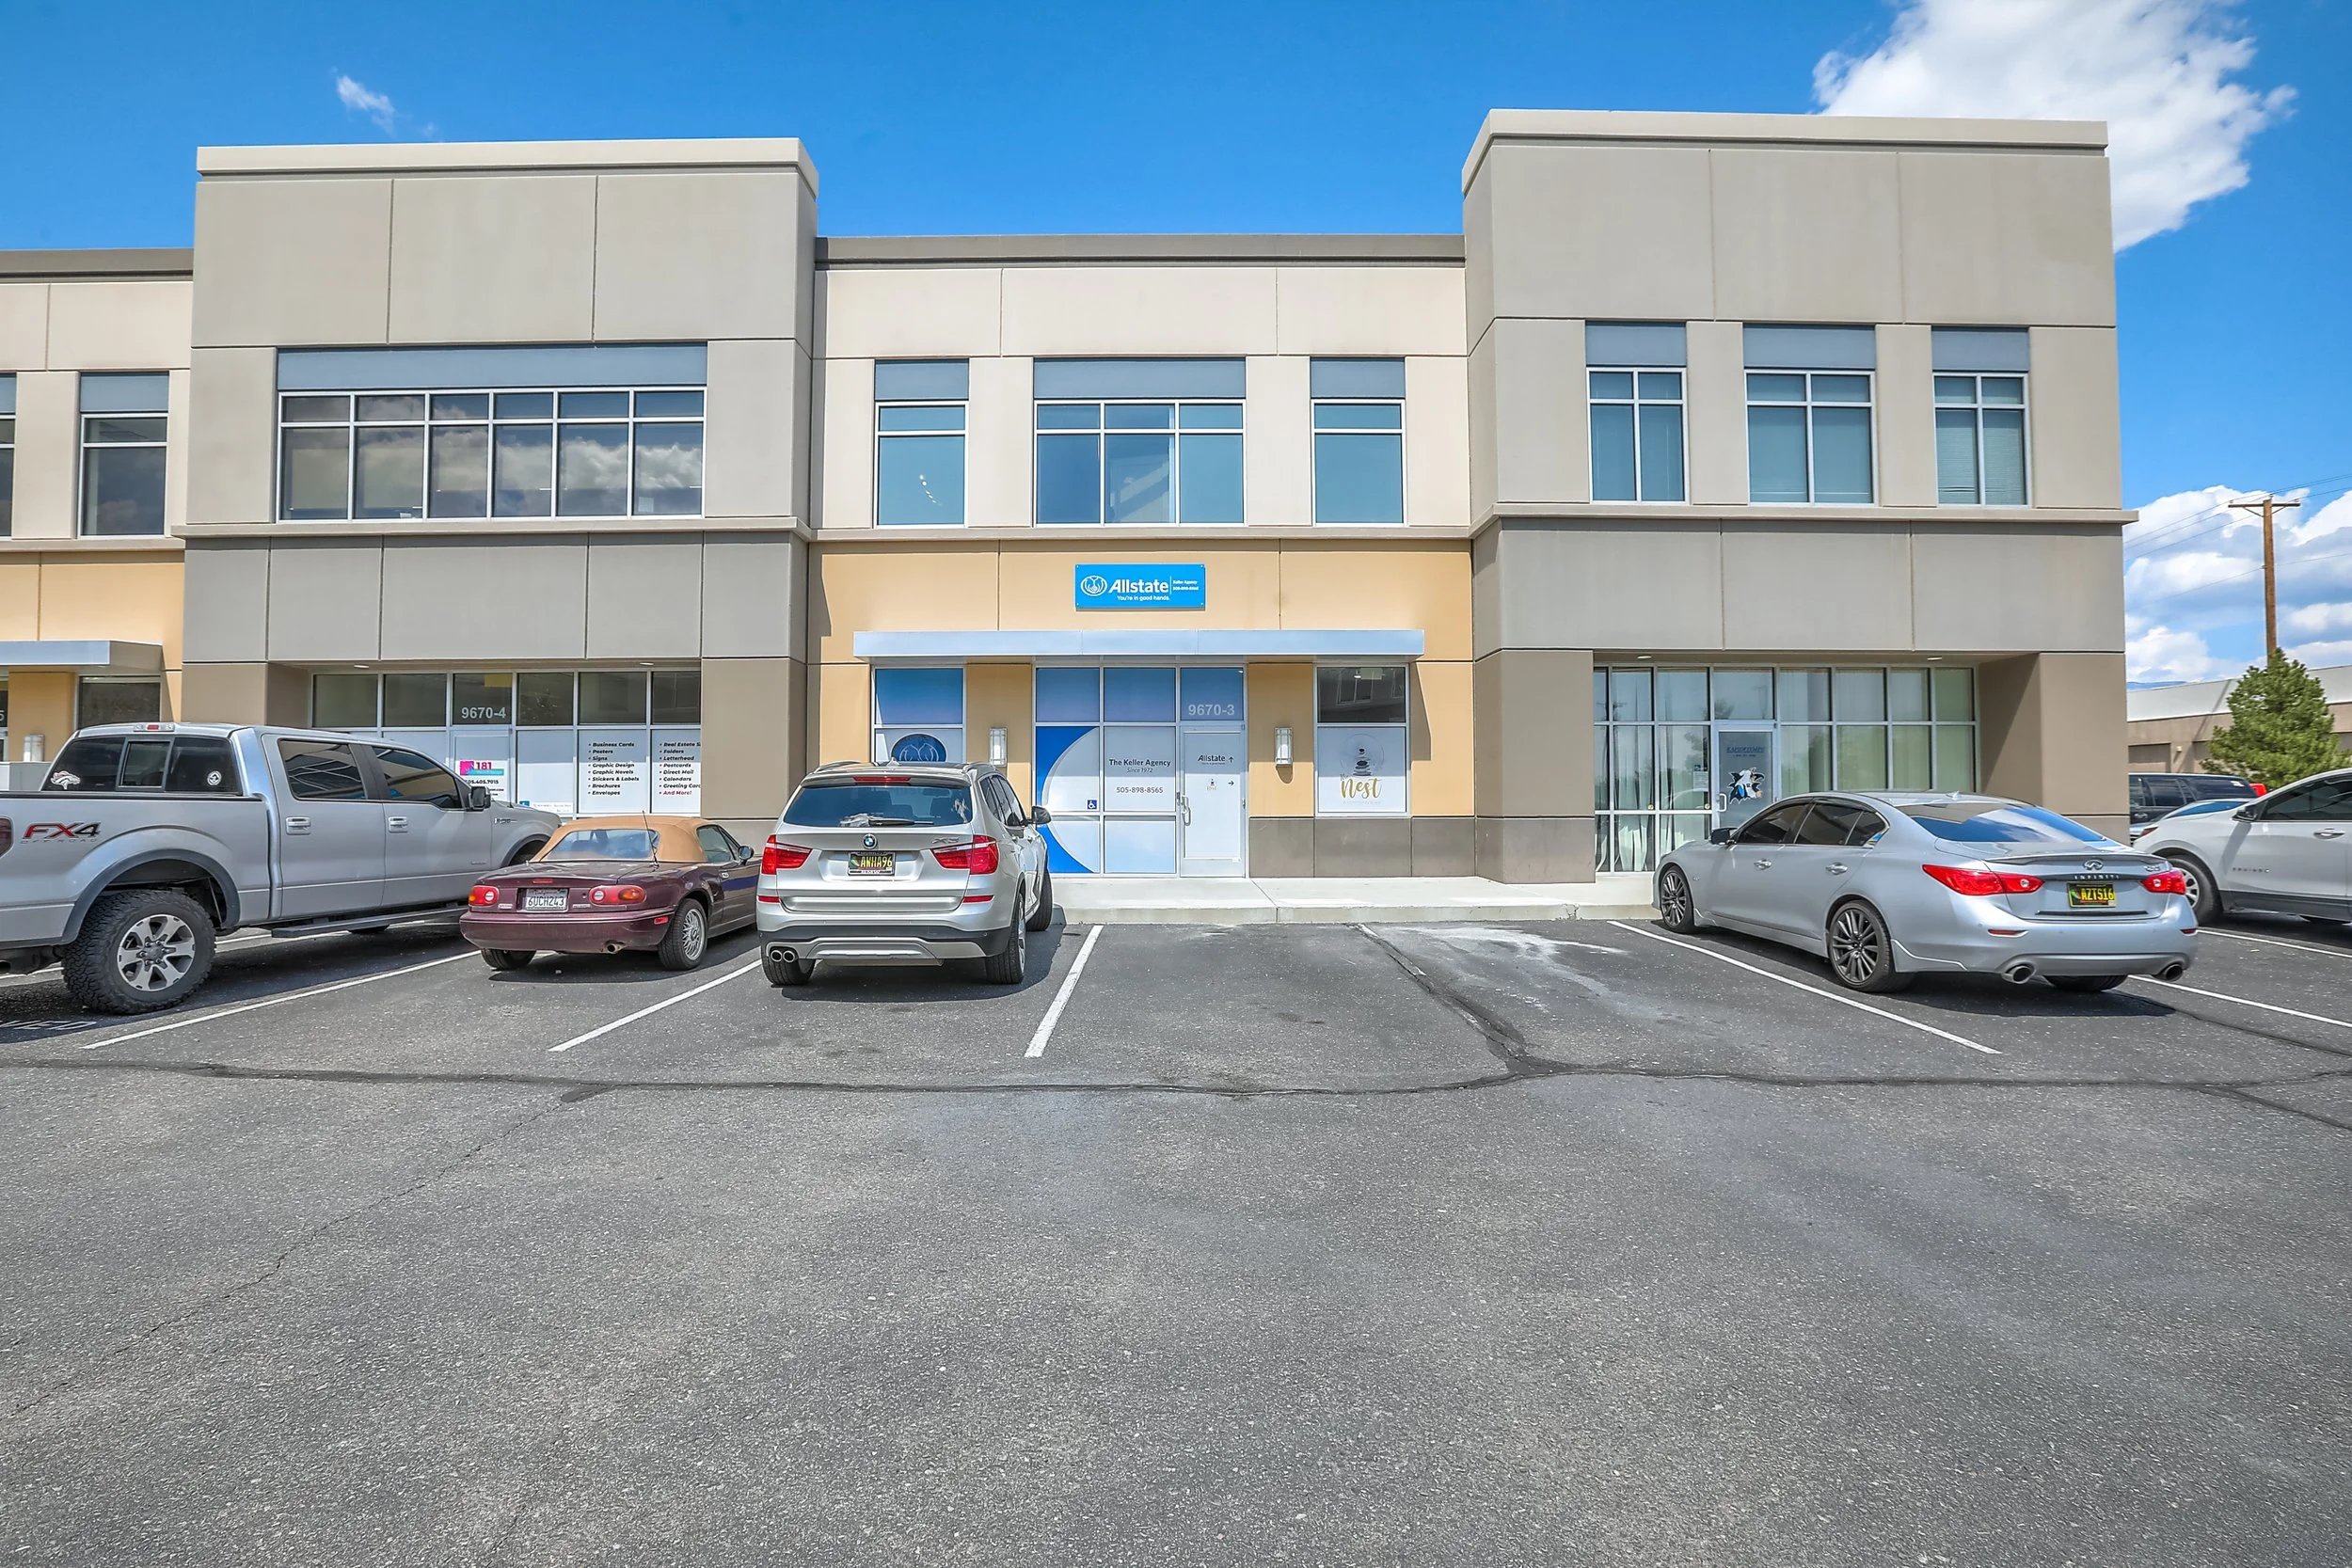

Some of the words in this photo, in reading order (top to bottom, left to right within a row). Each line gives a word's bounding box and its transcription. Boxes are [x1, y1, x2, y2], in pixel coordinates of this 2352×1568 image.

[1108, 579, 1169, 593] Allstate
[461, 707, 506, 718] 9670-4
[1189, 704, 1235, 715] 9670-3
[23, 822, 101, 839] FX4
[528, 896, 564, 906] 6UCH243
